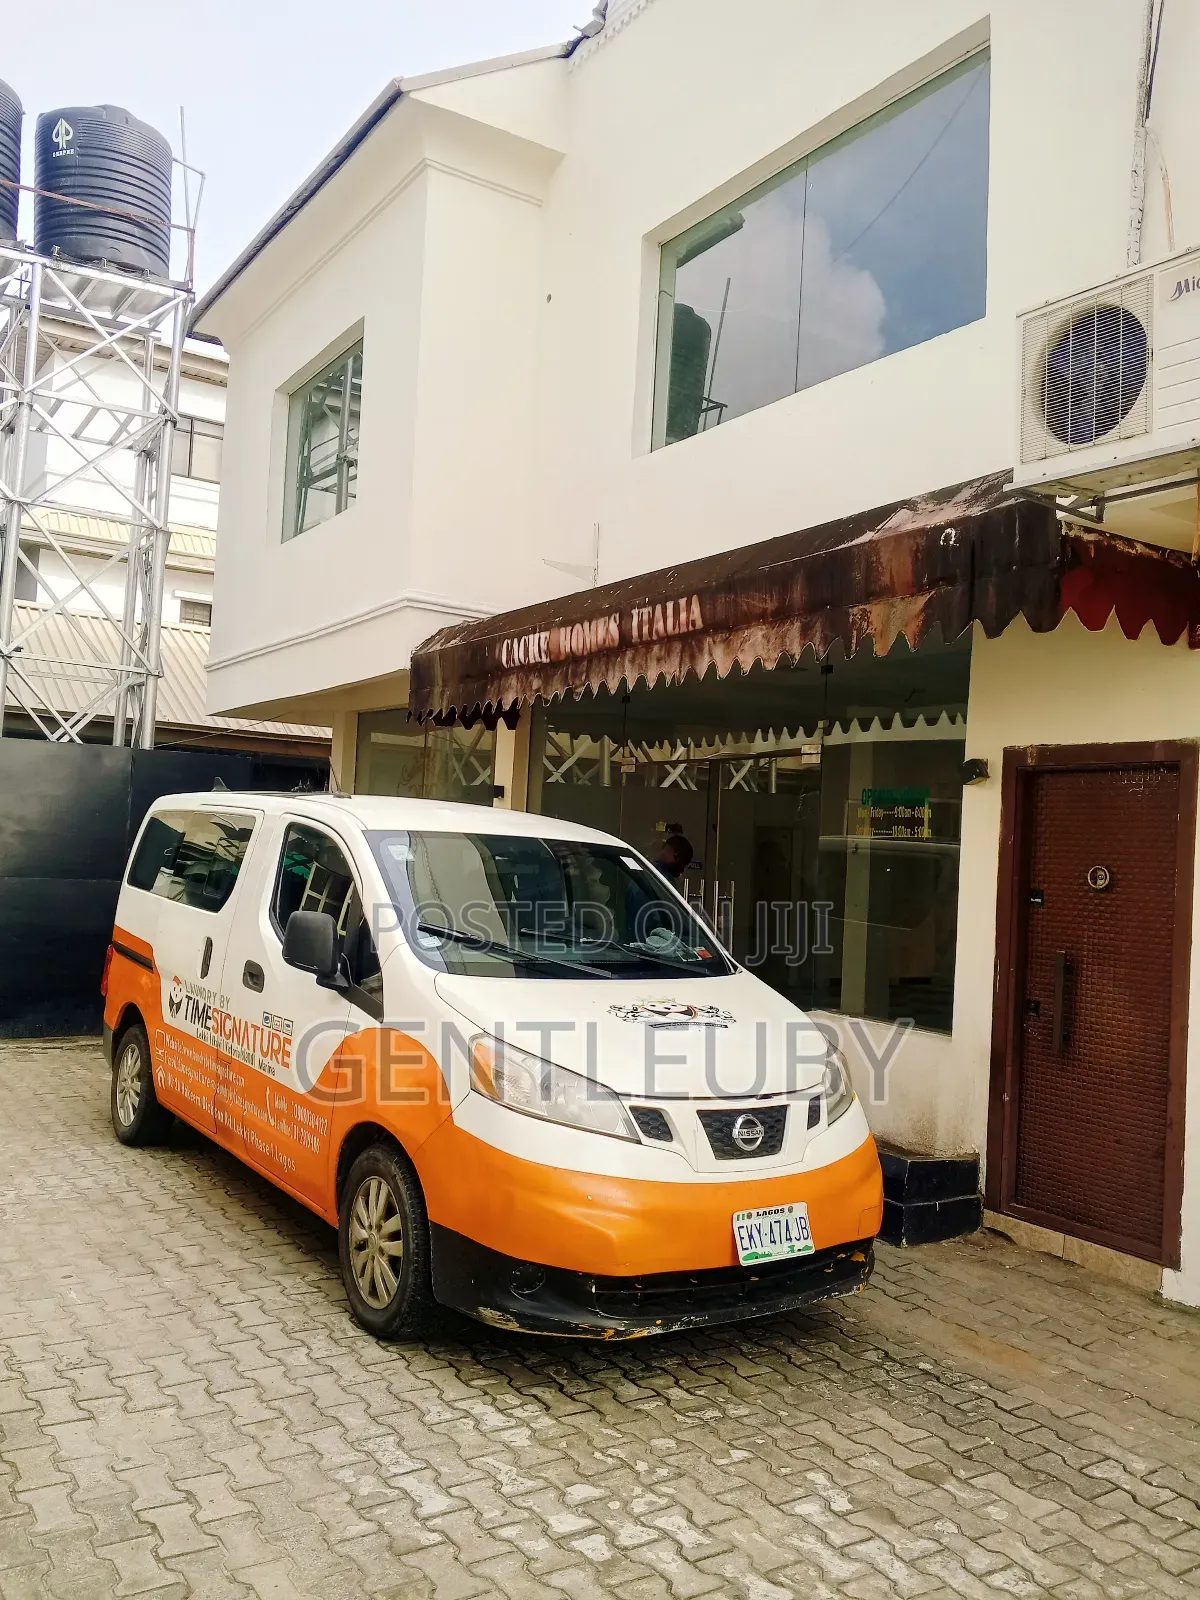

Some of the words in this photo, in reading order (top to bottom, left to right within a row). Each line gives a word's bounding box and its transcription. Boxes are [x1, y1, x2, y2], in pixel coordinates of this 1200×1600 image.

[559, 612, 620, 661] HOMES
[631, 594, 703, 643] ITALIA
[184, 980, 217, 1006] LAUNDRY
[220, 994, 230, 1011] BY
[185, 994, 292, 1069] TIMESIGNATURE
[251, 1131, 269, 1155] Phase
[737, 1129, 763, 1137] NISSAN
[756, 1207, 785, 1217] LAGOS
